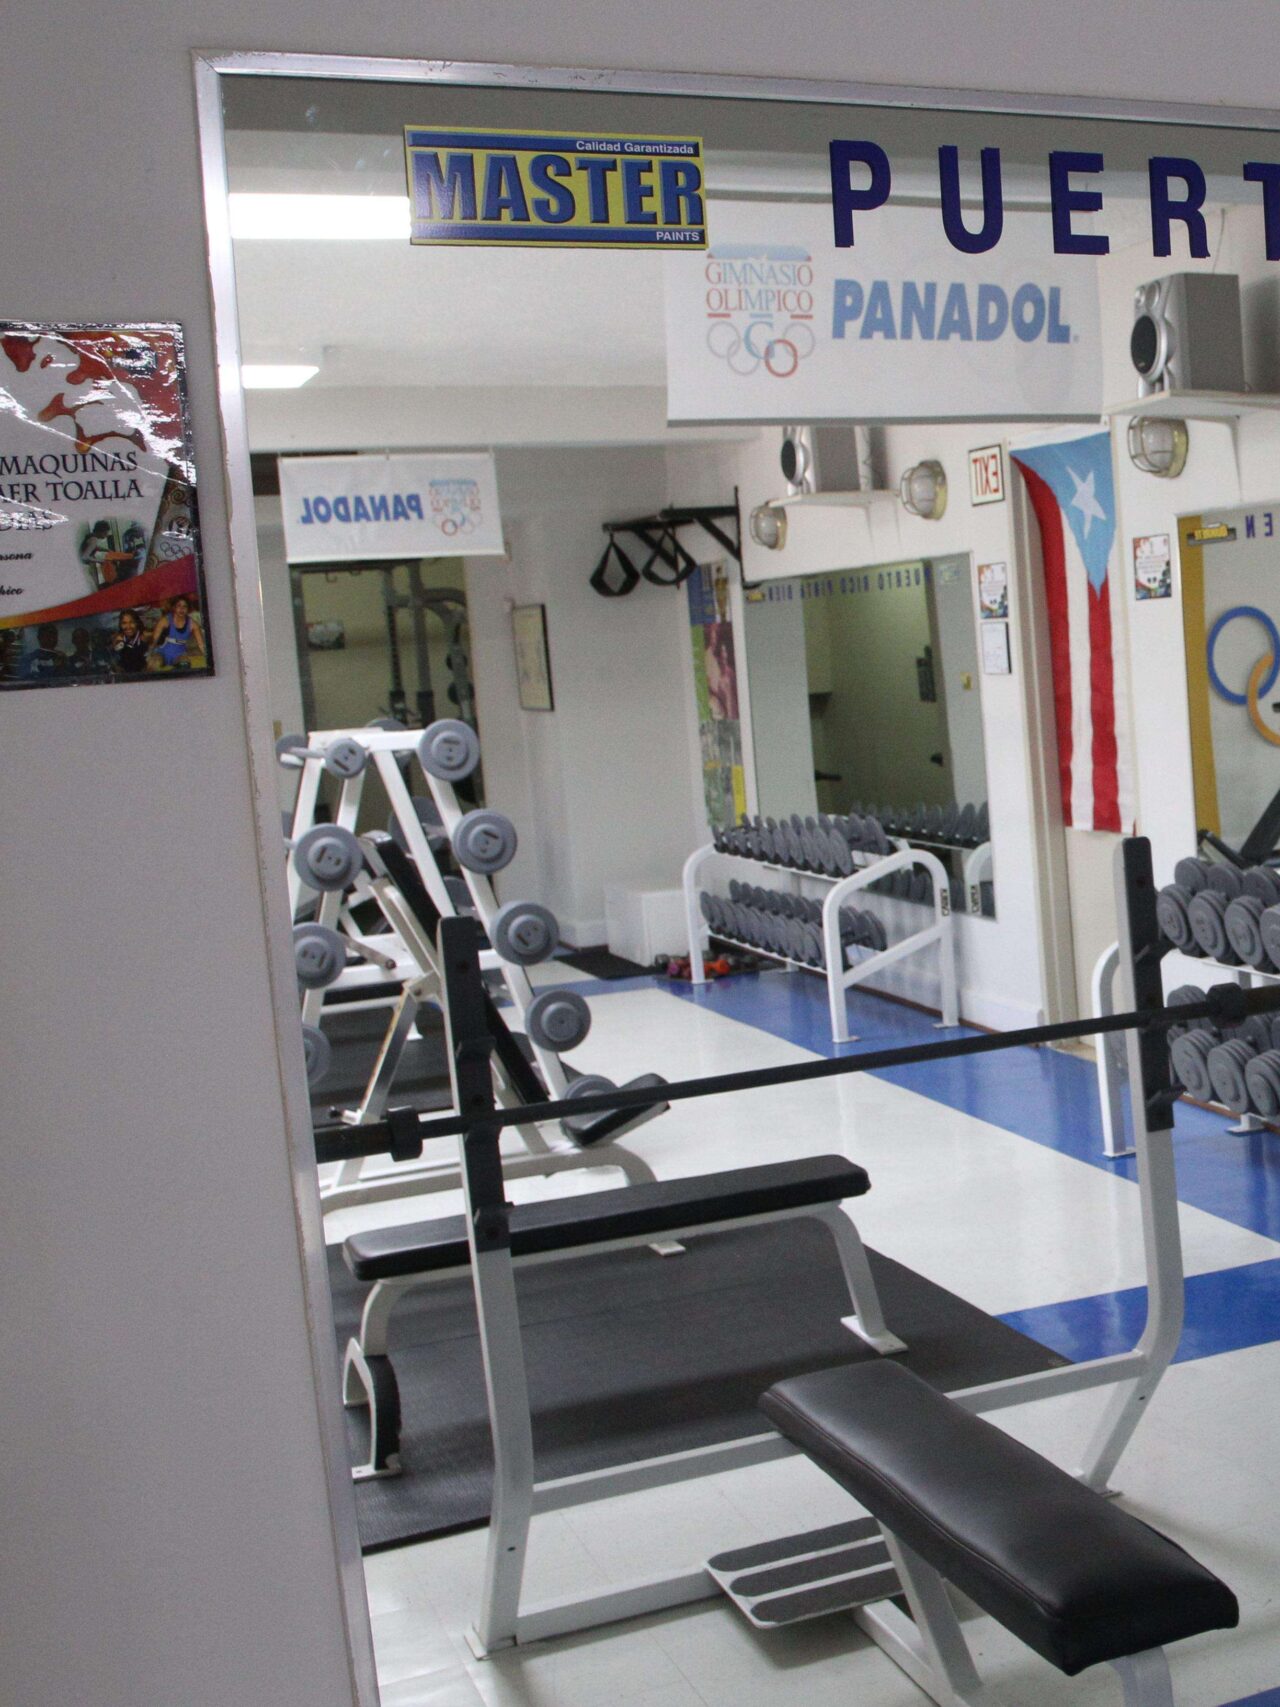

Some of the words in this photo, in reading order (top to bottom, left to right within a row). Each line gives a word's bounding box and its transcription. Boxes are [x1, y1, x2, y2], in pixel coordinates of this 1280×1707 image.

[575, 140, 621, 152] Calidad
[623, 142, 694, 154] Garantizada
[411, 151, 704, 226] MASTER
[655, 231, 700, 241] PAINTS
[704, 261, 814, 287] GIMNASIO
[831, 278, 1071, 344] PANADOL
[0, 450, 138, 479] MAQUINAS
[46, 479, 144, 501] TOALLA
